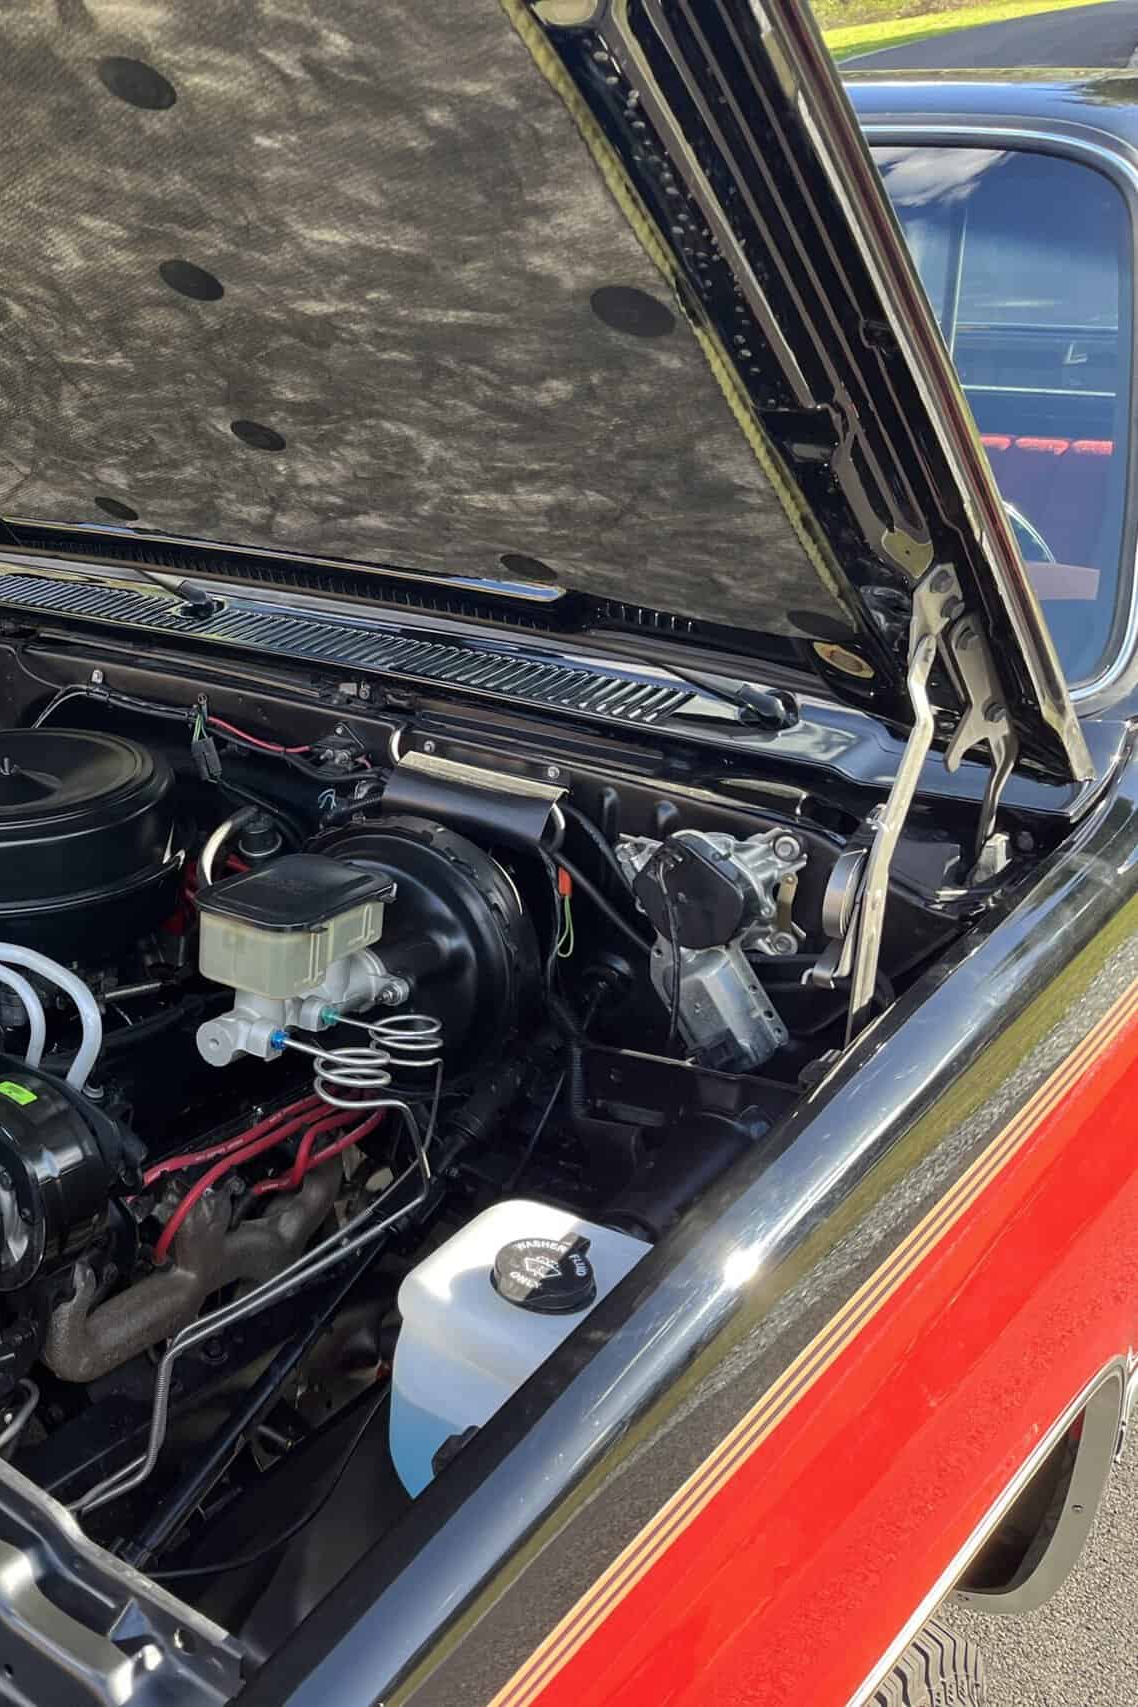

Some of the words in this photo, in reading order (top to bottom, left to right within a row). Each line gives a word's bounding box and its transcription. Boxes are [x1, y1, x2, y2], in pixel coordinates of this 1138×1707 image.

[514, 1239, 568, 1253] WASHER
[569, 1253, 587, 1277] FLUID
[510, 1271, 542, 1288] ONLY
